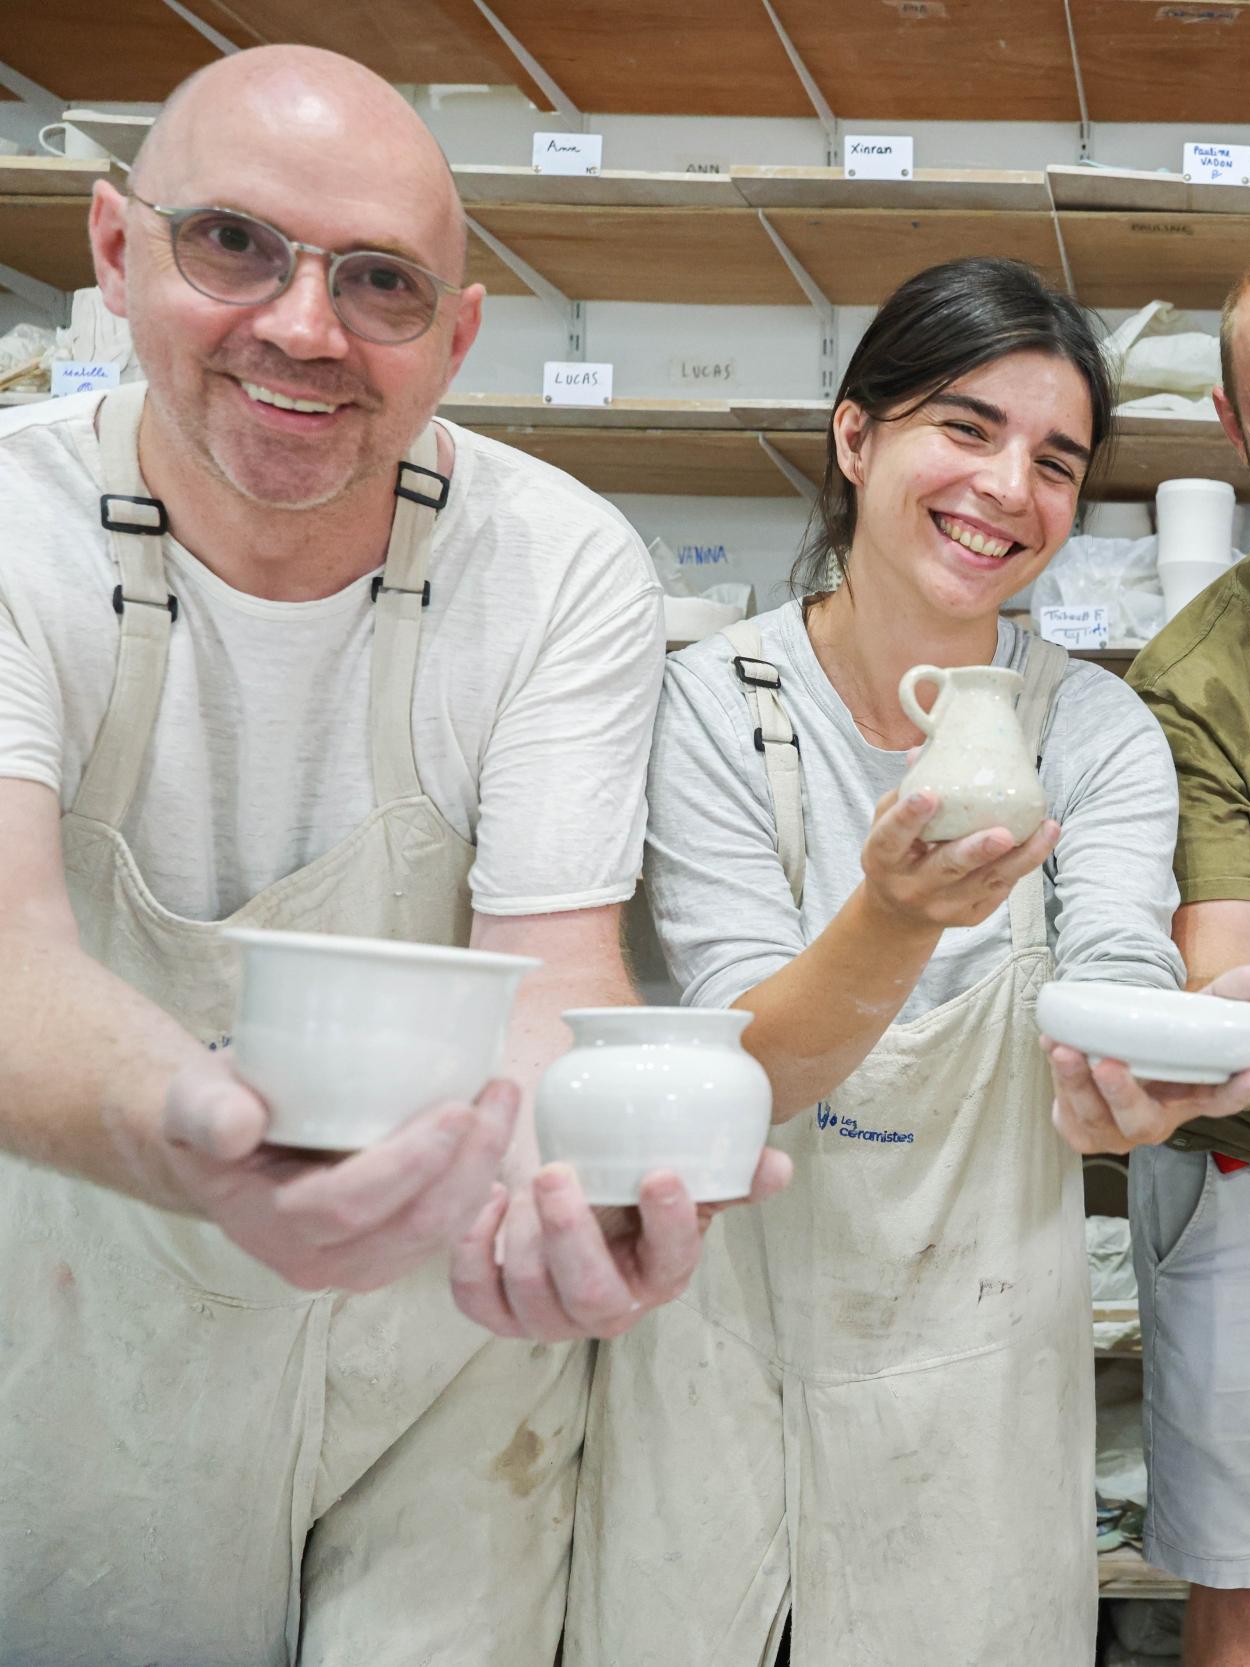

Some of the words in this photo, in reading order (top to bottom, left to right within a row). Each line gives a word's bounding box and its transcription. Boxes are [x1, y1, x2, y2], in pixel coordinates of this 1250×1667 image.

[851, 143, 893, 154] Xinran
[681, 362, 732, 380] LUCAS
[555, 372, 598, 386] LUCAS
[841, 1116, 857, 1126] Les
